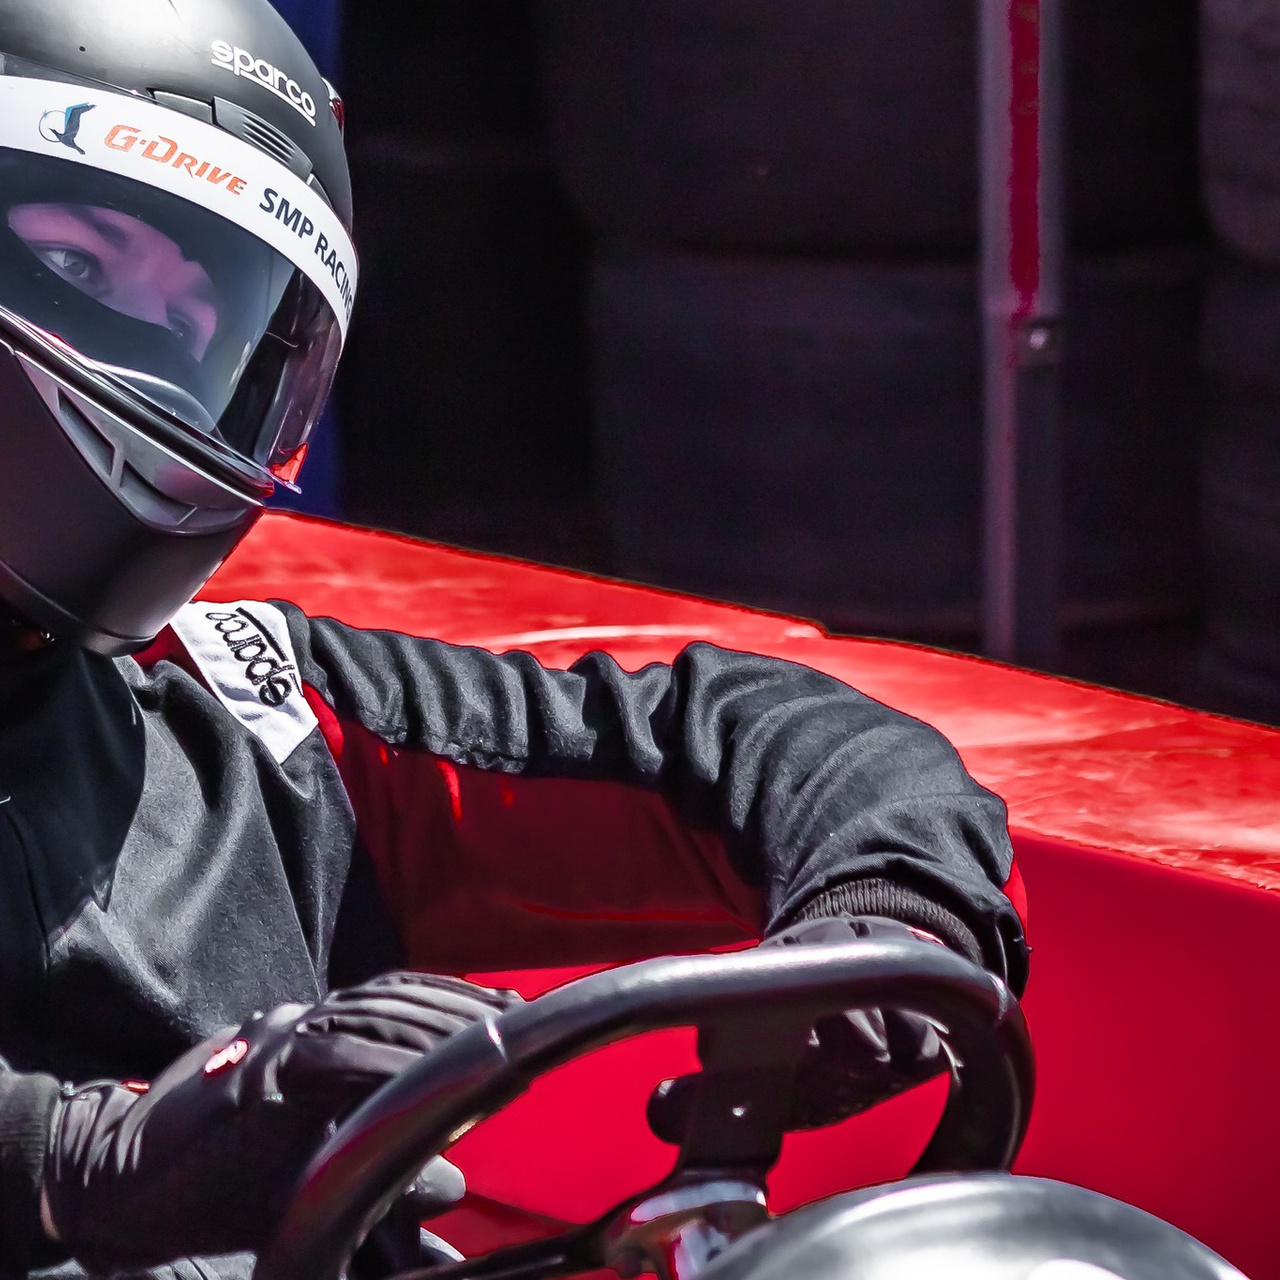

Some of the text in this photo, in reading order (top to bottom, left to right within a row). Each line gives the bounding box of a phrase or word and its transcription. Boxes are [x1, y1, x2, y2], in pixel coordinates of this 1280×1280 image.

[211, 39, 316, 126] sparco
[259, 187, 314, 239] SMP
[314, 231, 354, 322] RACING
[205, 607, 296, 708] sparco
